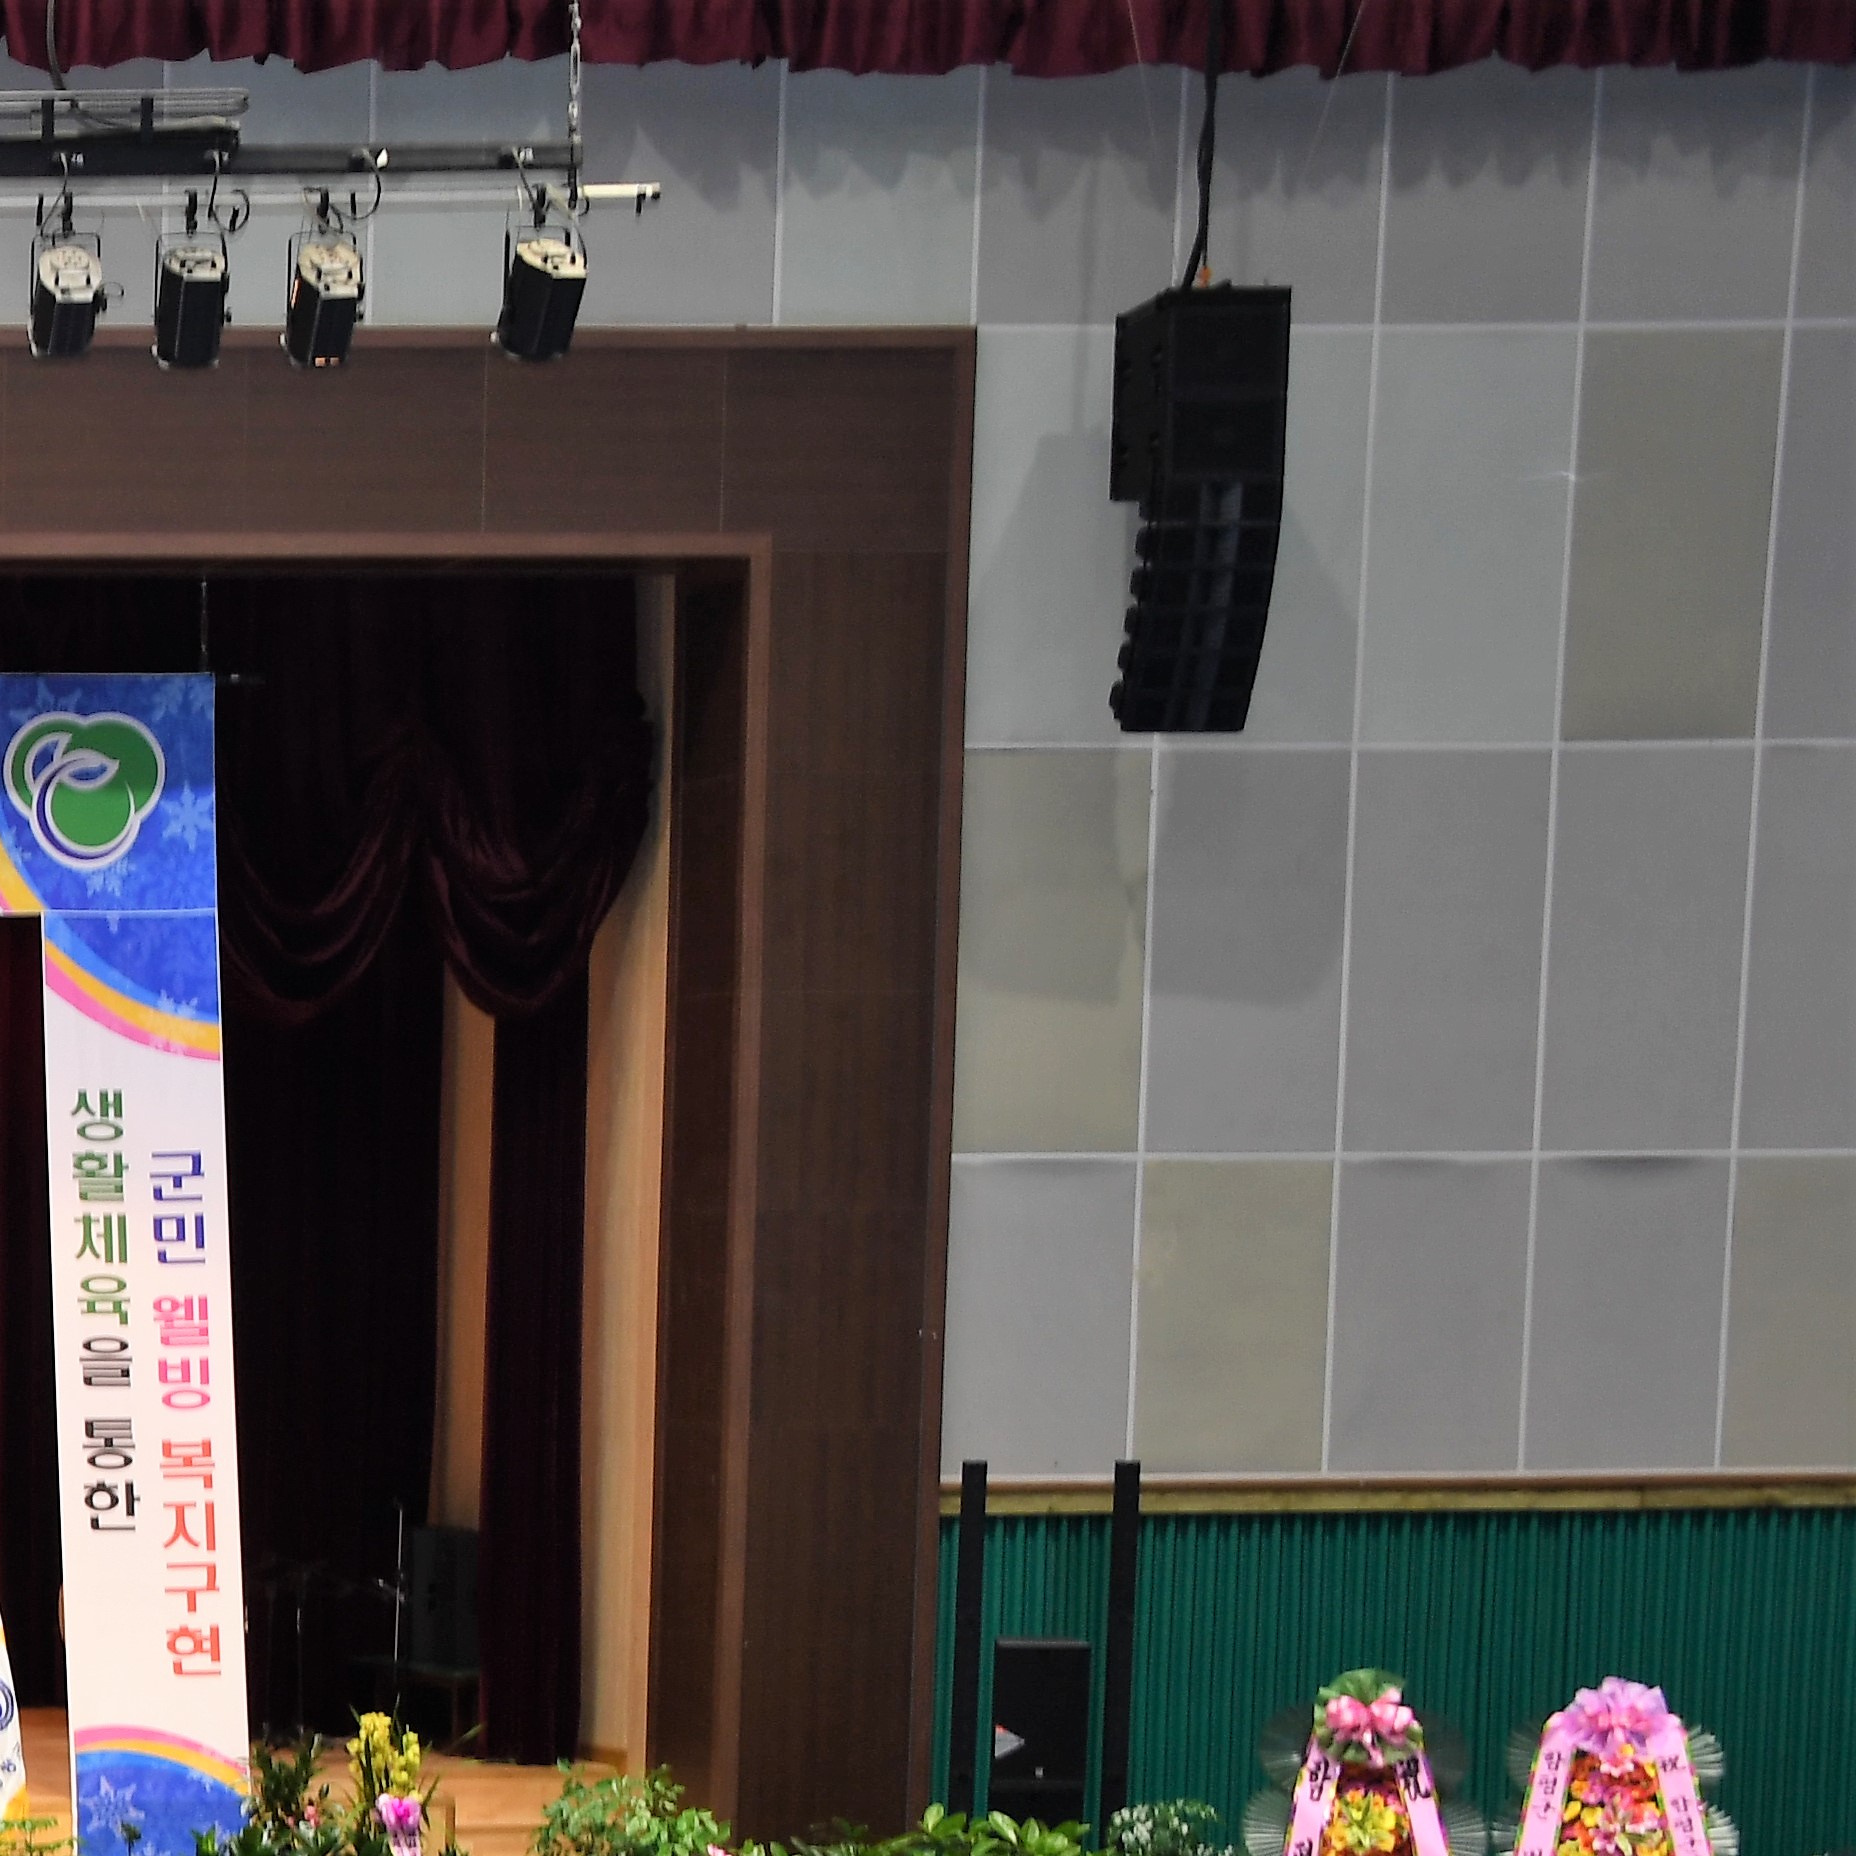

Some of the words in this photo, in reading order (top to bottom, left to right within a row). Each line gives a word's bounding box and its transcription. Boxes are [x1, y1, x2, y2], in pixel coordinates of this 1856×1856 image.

[70, 1087, 133, 1389] 생활체육을
[149, 1150, 206, 1265] 군민
[152, 1295, 212, 1411] 웰빙
[82, 1417, 141, 1532] 통한
[160, 1438, 222, 1677] 복지구현
